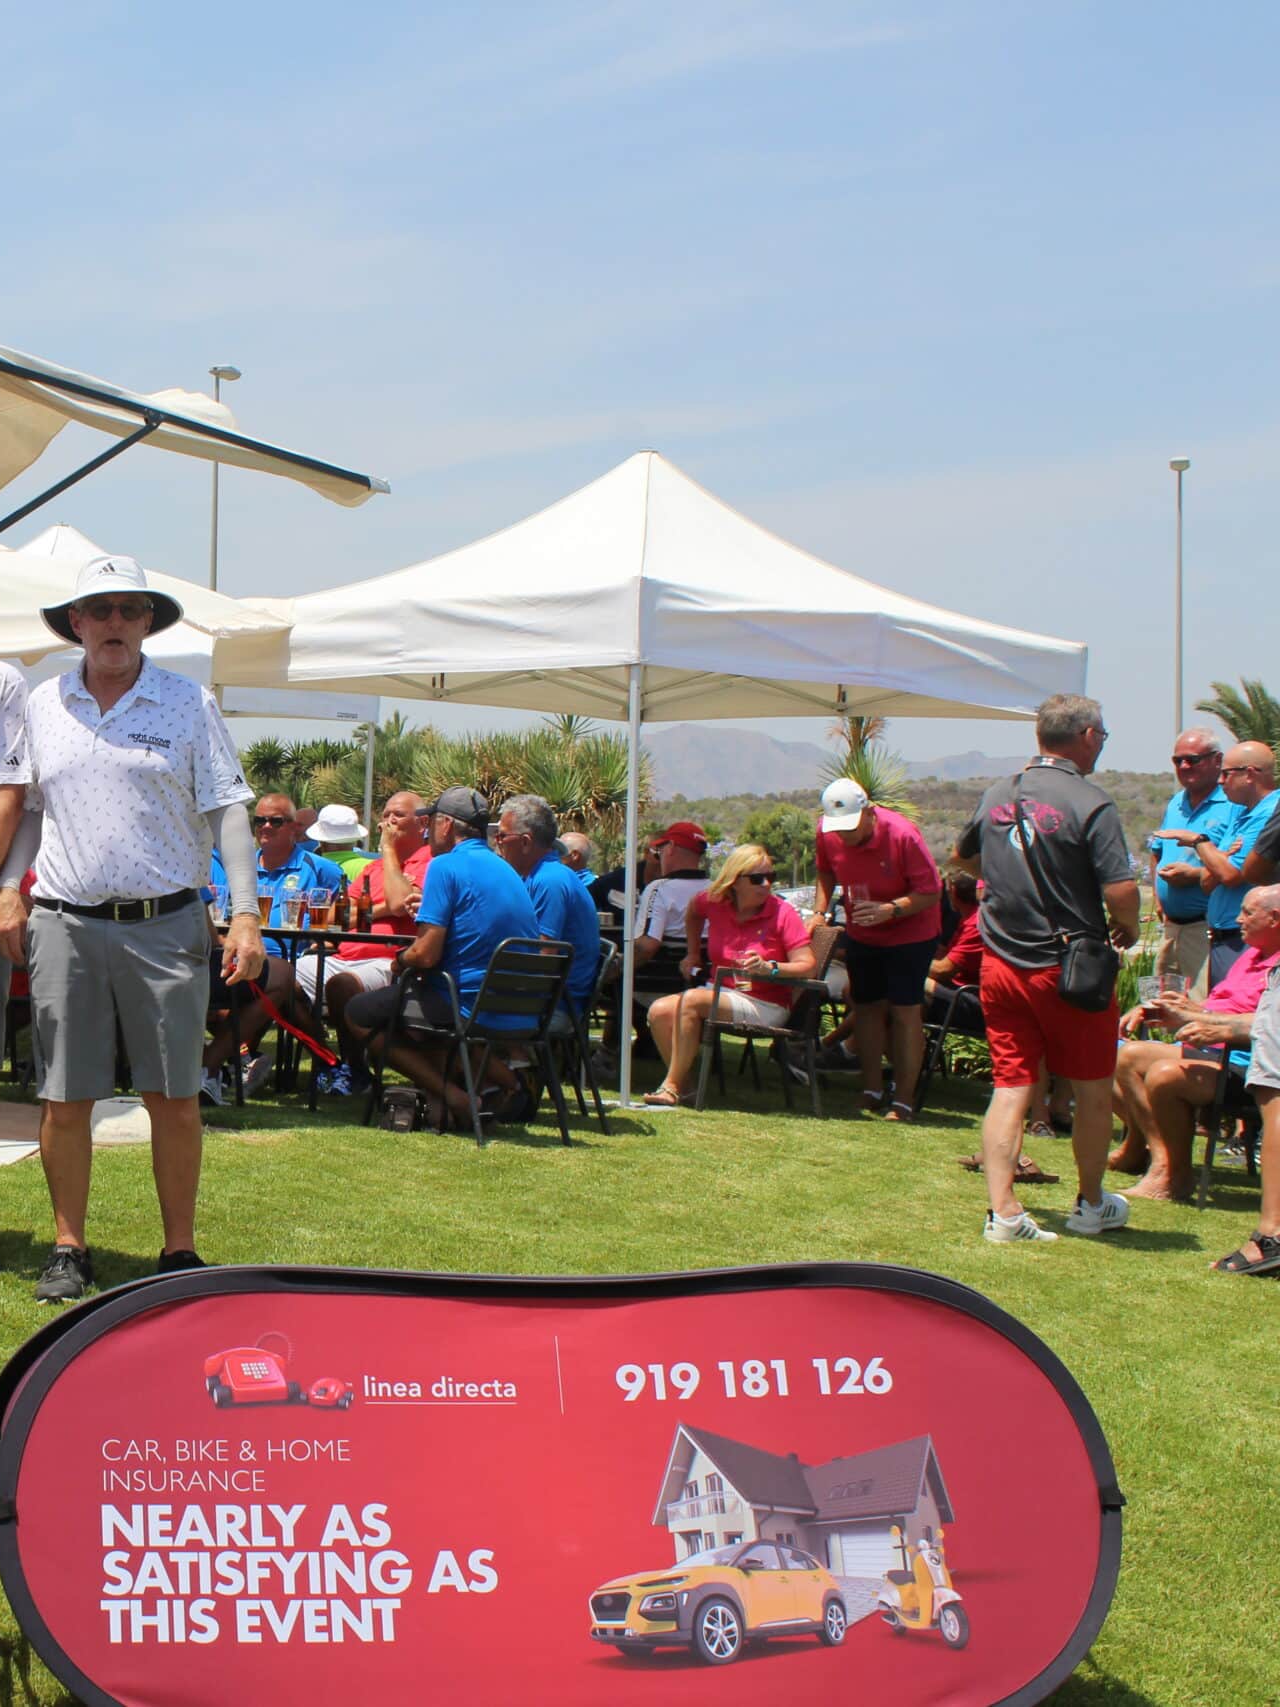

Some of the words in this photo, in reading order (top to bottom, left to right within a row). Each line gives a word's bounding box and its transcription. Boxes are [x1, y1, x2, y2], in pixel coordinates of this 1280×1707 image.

[363, 1375, 422, 1398] linea
[431, 1375, 517, 1398] directa
[615, 1362, 701, 1402] 919
[718, 1359, 789, 1398] 181
[812, 1356, 893, 1395] 126
[102, 1439, 167, 1464] CAR,
[175, 1439, 229, 1462] BIKE
[239, 1439, 257, 1462] &
[267, 1439, 351, 1462] HOME
[103, 1469, 265, 1492] INSURANCE
[101, 1504, 307, 1547] NEARLY
[319, 1503, 392, 1548] AS
[102, 1549, 413, 1596] SATISFYING
[427, 1548, 499, 1594] AS
[100, 1598, 220, 1644] THIS
[235, 1598, 402, 1643] EVENT
